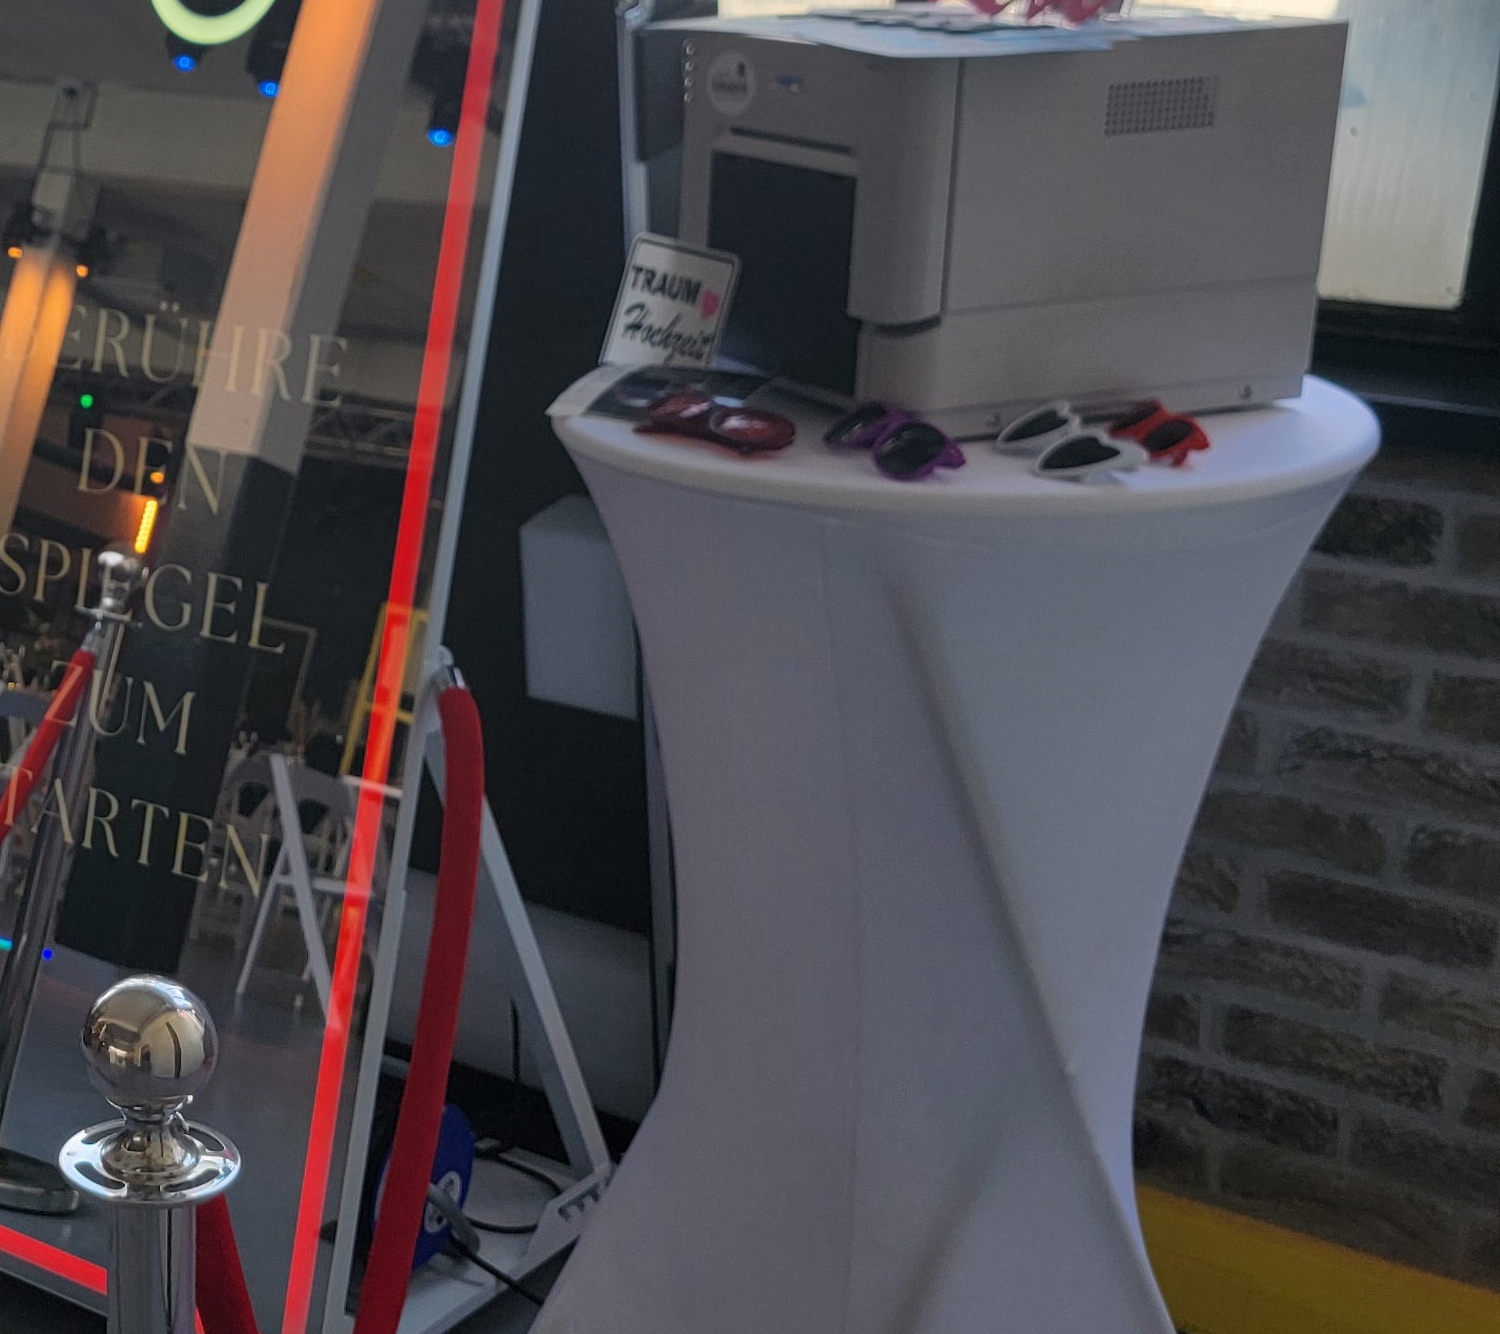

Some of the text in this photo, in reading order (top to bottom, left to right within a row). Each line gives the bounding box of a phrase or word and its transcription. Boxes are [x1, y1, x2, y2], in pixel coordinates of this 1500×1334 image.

[631, 264, 703, 307] TRAUM
[10, 296, 348, 408] ERÜHRE
[77, 427, 230, 516] DEN
[44, 659, 197, 756] ZUM
